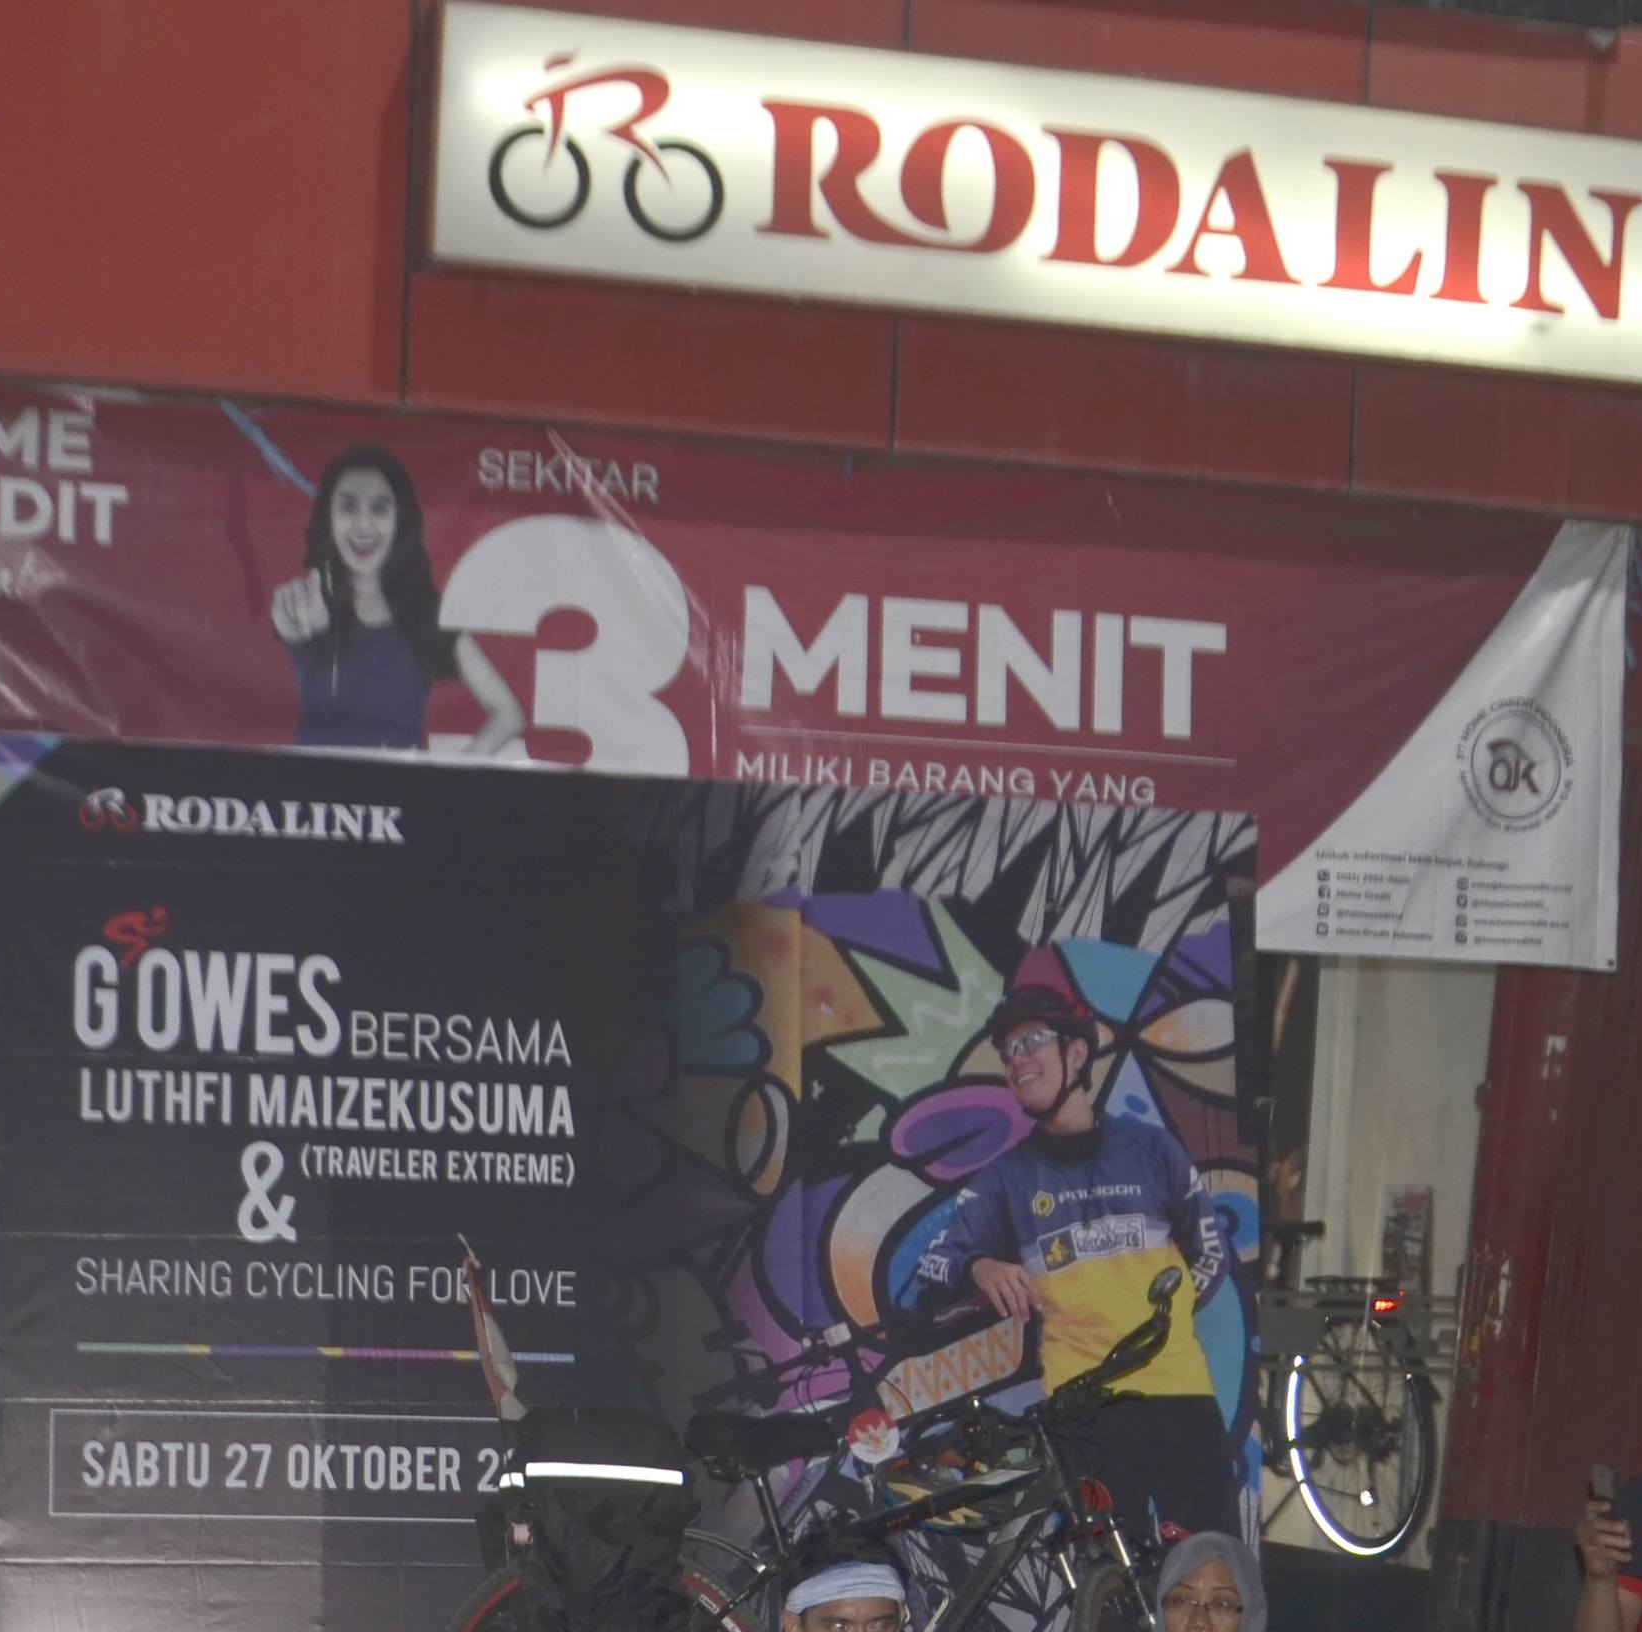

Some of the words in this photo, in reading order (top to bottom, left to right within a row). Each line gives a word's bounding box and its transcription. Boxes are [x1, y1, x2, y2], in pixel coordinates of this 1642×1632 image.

[478, 447, 660, 503] SEKITAR
[427, 512, 691, 776] 3
[741, 584, 1227, 740] MENIT
[737, 750, 853, 788] MILIKI
[868, 759, 1037, 798] BARANG
[1048, 769, 1156, 807] YANG
[142, 793, 405, 844] RODALINK
[72, 944, 342, 1059] GOWES
[350, 1010, 573, 1068] BERSAMA
[79, 1067, 233, 1128] LUTHFI
[249, 1072, 577, 1138] MAIZEKUSUMA
[236, 1140, 297, 1243] &
[299, 1142, 439, 1182] (TRAVELER
[446, 1149, 576, 1188] EXTREME)
[74, 1256, 233, 1299] SHARING
[246, 1261, 395, 1302] CYCLING
[410, 1265, 471, 1304] FOR
[490, 1268, 578, 1308] LOVE
[81, 1440, 210, 1489] SABTU
[224, 1442, 272, 1488] 27
[287, 1443, 461, 1492] OKTOBER
